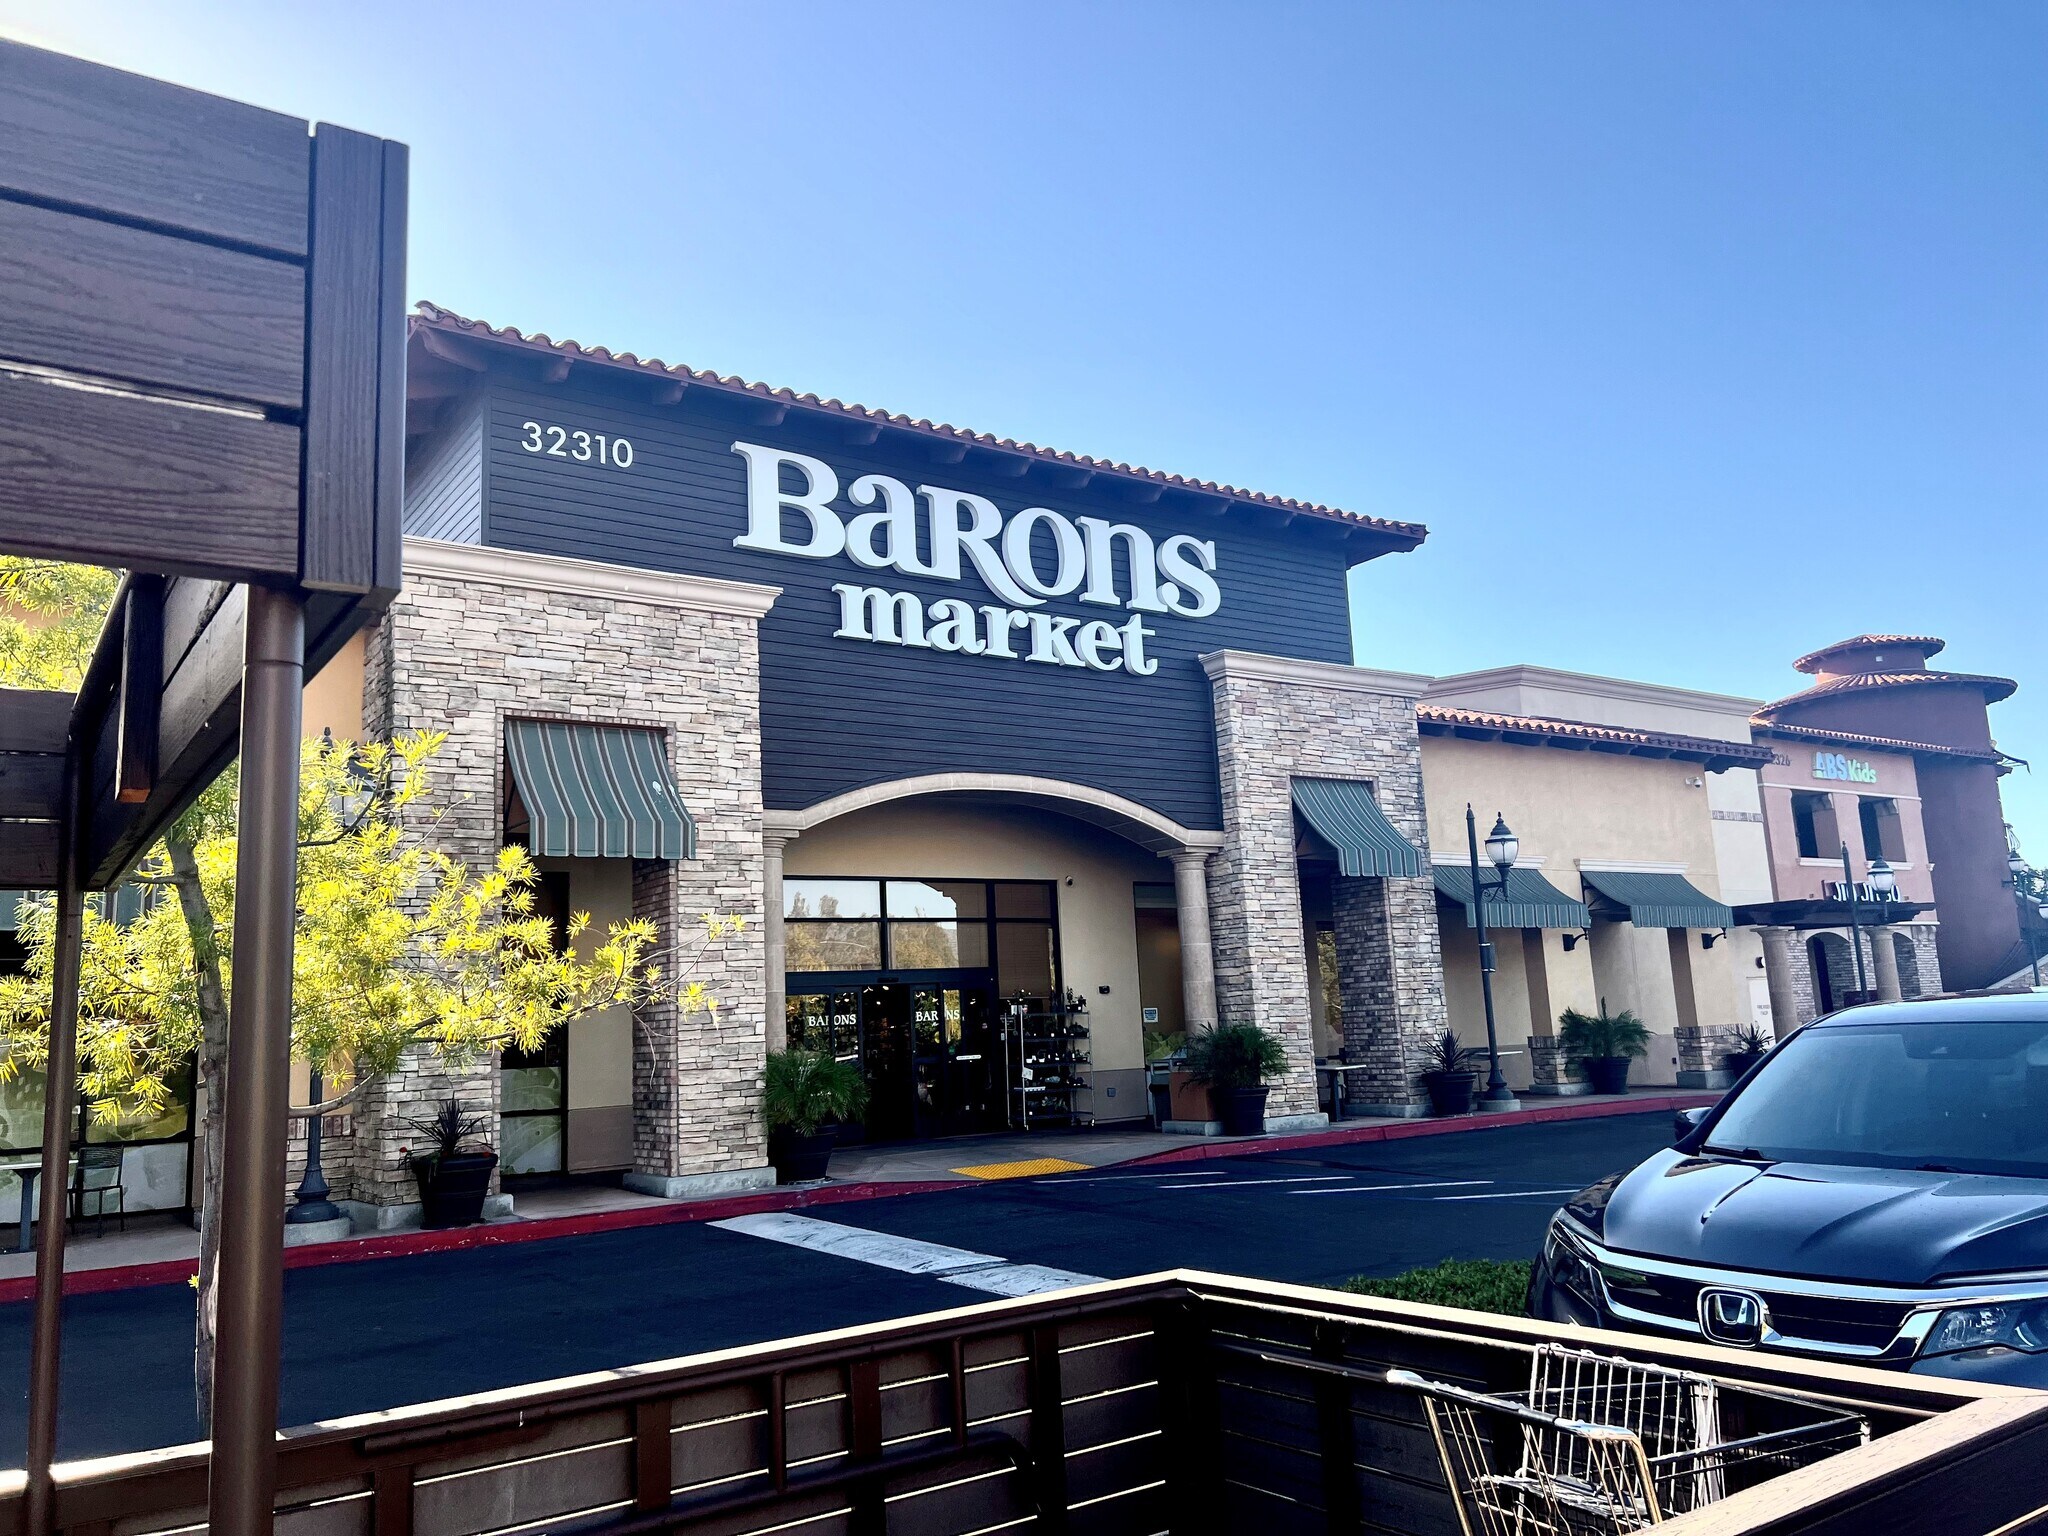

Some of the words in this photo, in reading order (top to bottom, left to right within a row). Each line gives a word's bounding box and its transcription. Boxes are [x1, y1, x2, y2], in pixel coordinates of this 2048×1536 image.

[521, 421, 634, 468] 32310
[831, 581, 1158, 676] market
[1814, 751, 1848, 780] ABS
[1847, 758, 1877, 783] Kids
[915, 1009, 960, 1022] BARNS
